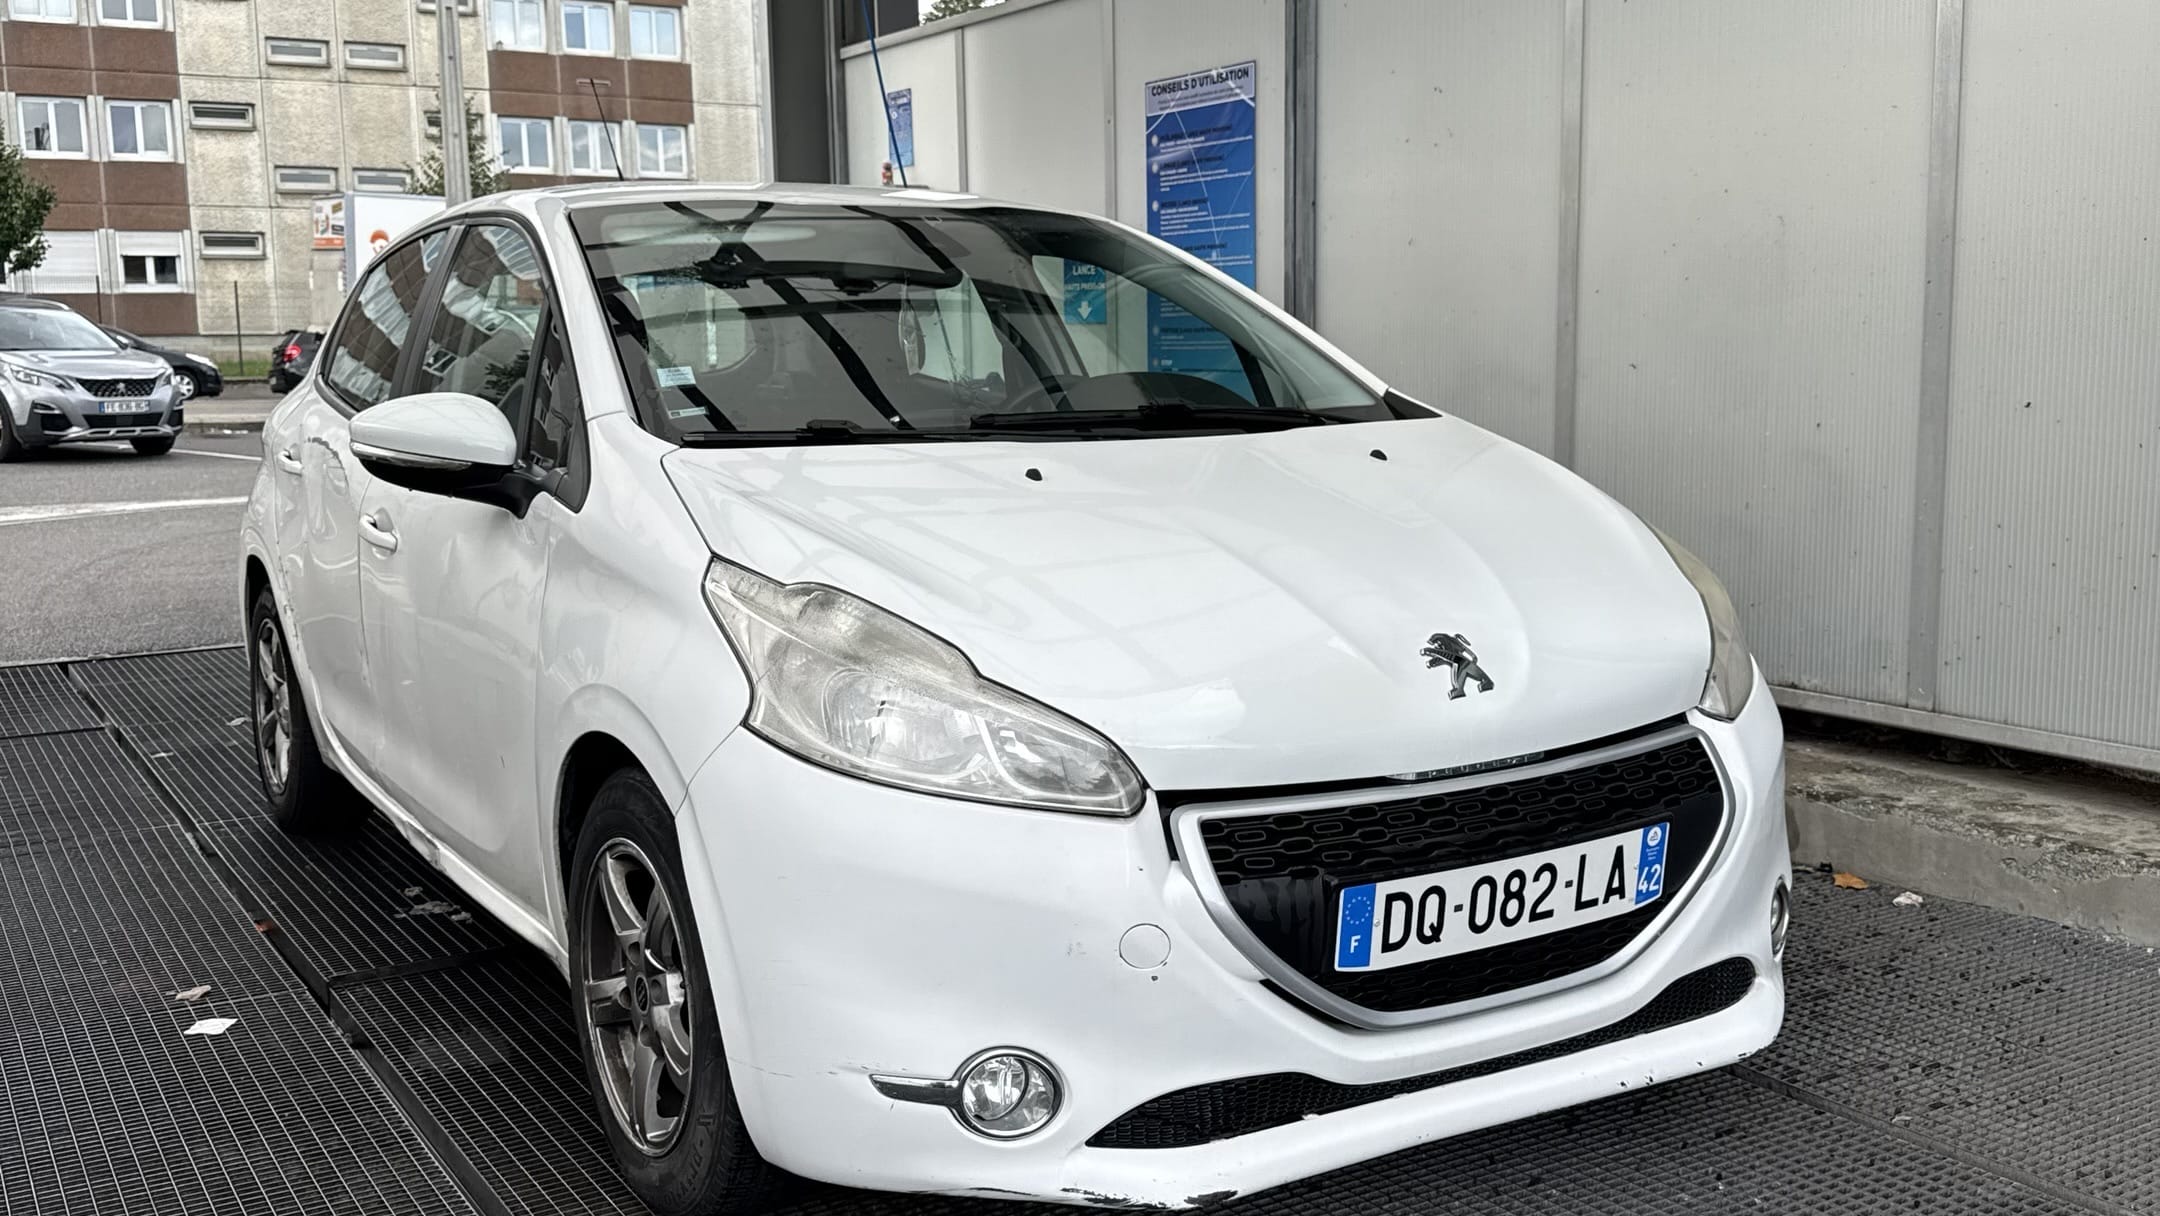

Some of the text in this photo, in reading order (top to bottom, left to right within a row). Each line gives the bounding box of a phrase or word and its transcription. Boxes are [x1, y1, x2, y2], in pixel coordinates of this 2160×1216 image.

[1151, 67, 1250, 97] CONSEILS D'UTILISATION
[1072, 264, 1096, 276] LANCE
[1638, 863, 1661, 894] 42
[1380, 845, 1626, 954] DQ-082-LA
[1349, 934, 1361, 954] F
